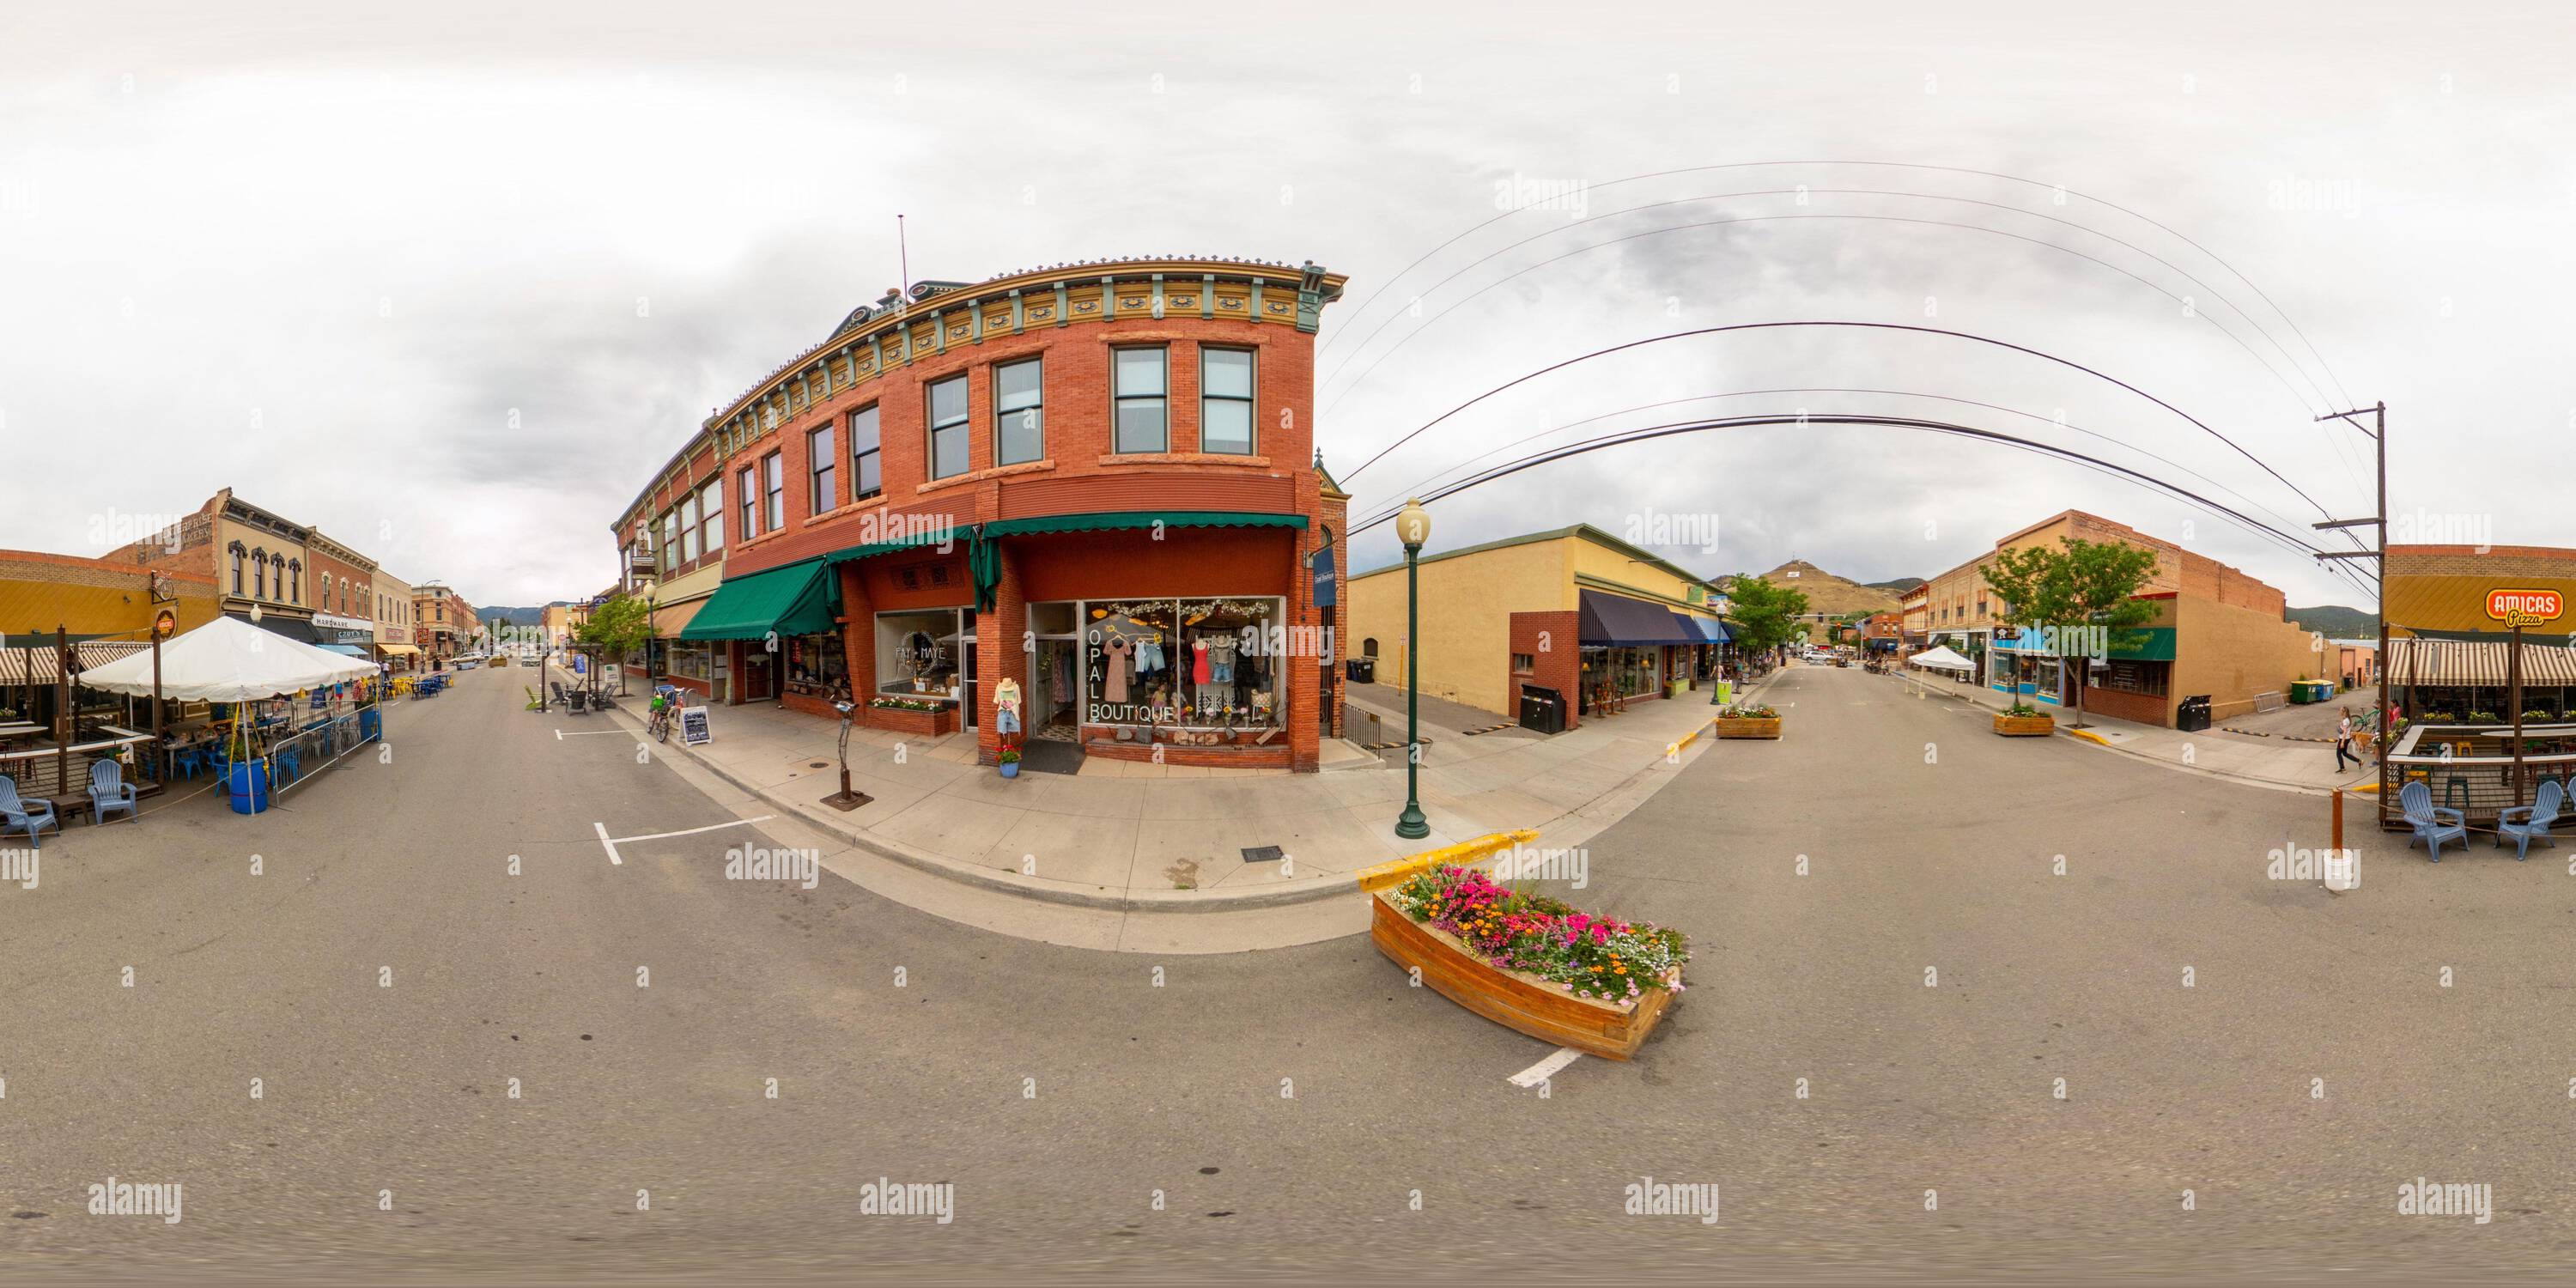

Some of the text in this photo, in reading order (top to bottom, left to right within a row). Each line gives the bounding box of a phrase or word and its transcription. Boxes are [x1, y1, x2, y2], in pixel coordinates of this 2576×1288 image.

[2494, 595, 2555, 612] AMICAS
[316, 618, 348, 628] HARDWARE
[2506, 609, 2542, 626] Pizza
[896, 647, 946, 659] FAY MAYE
[1089, 629, 1101, 699] OPAL
